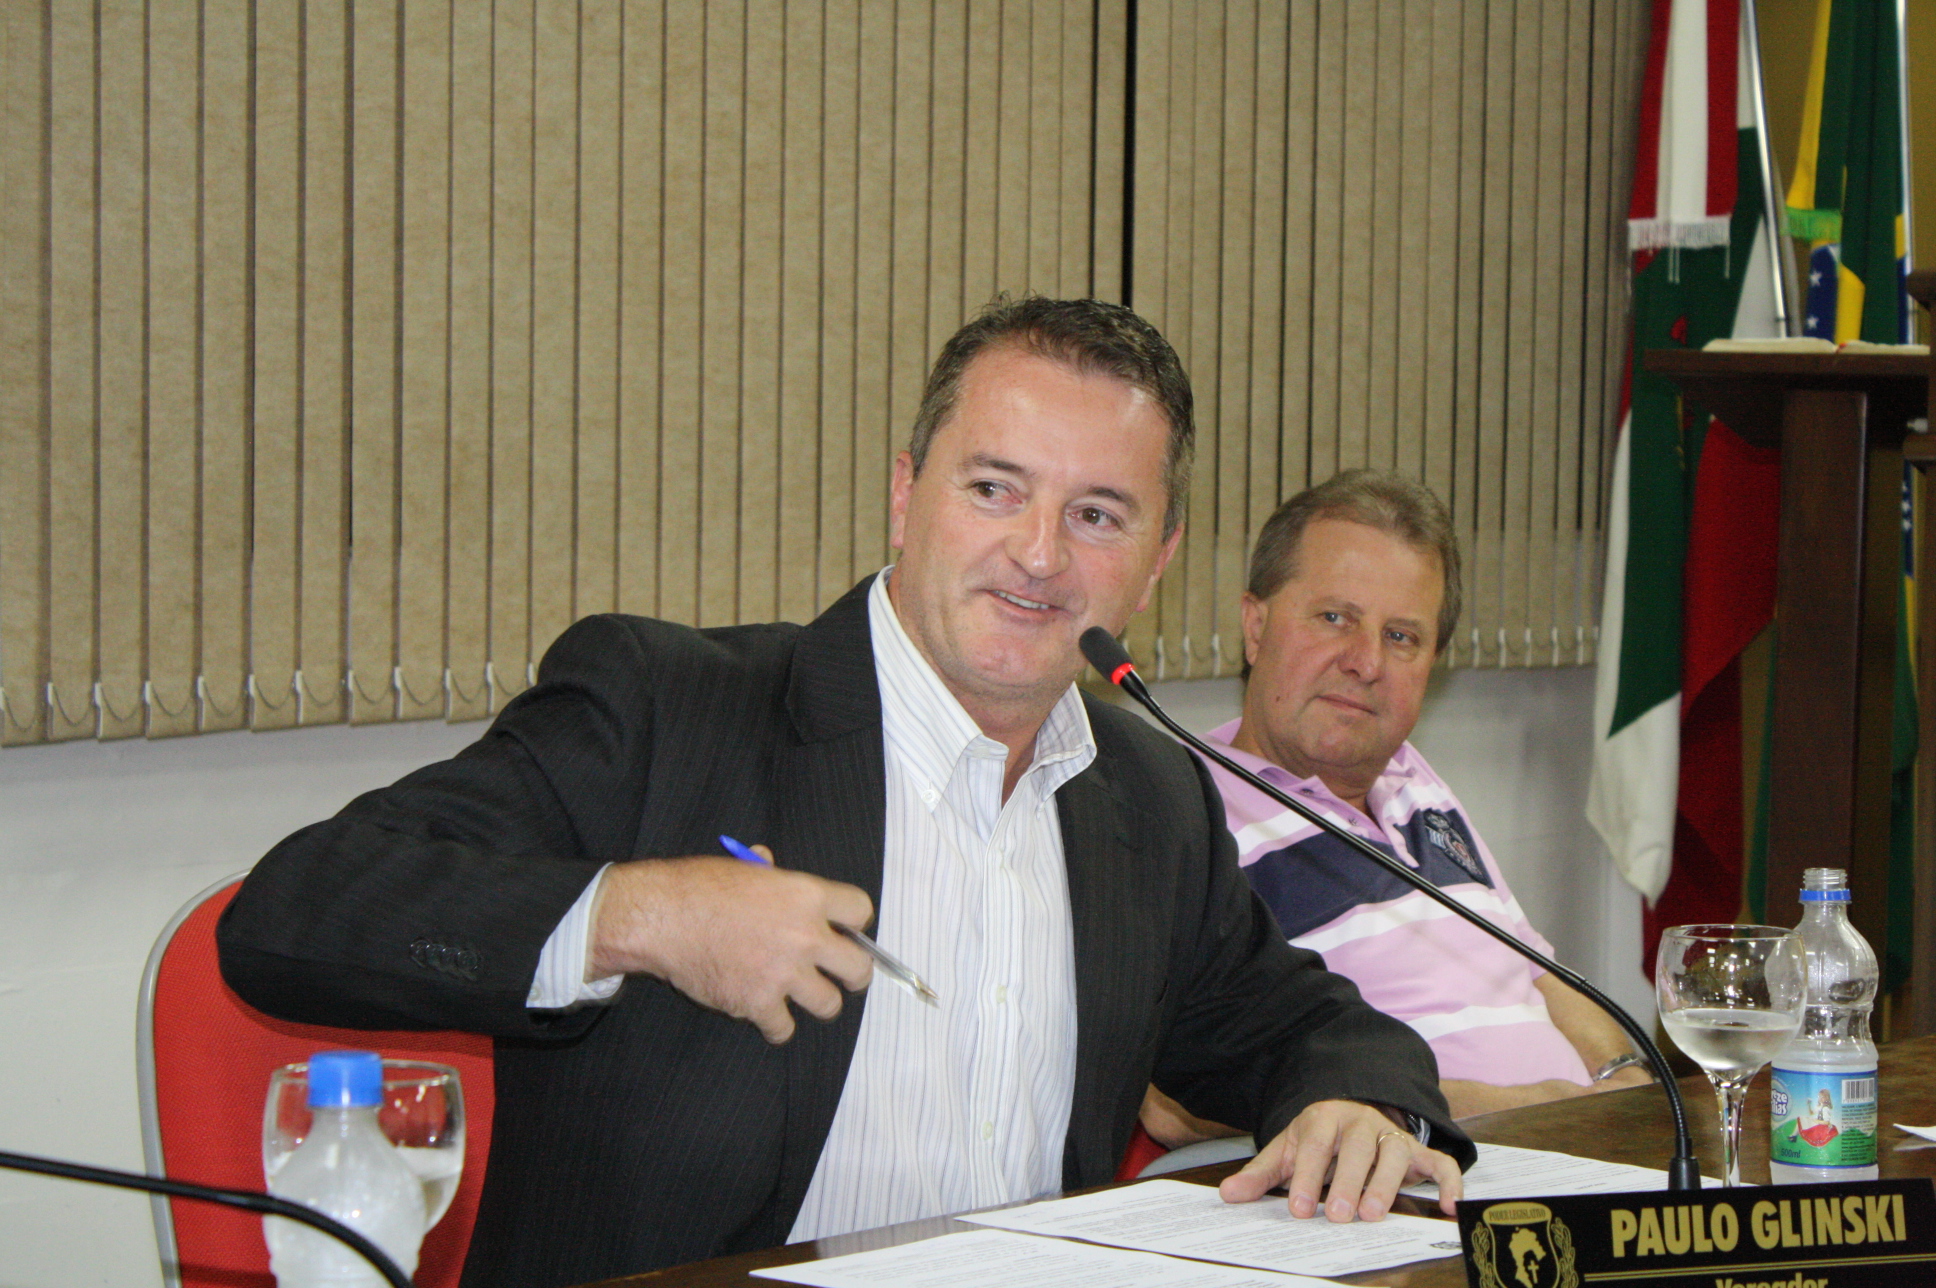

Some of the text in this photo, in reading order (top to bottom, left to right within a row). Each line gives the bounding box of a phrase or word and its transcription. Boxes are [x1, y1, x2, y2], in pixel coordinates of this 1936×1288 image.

[1781, 1148, 1801, 1158] 500ml
[1611, 1194, 1907, 1258] PAULO GLINSKI
